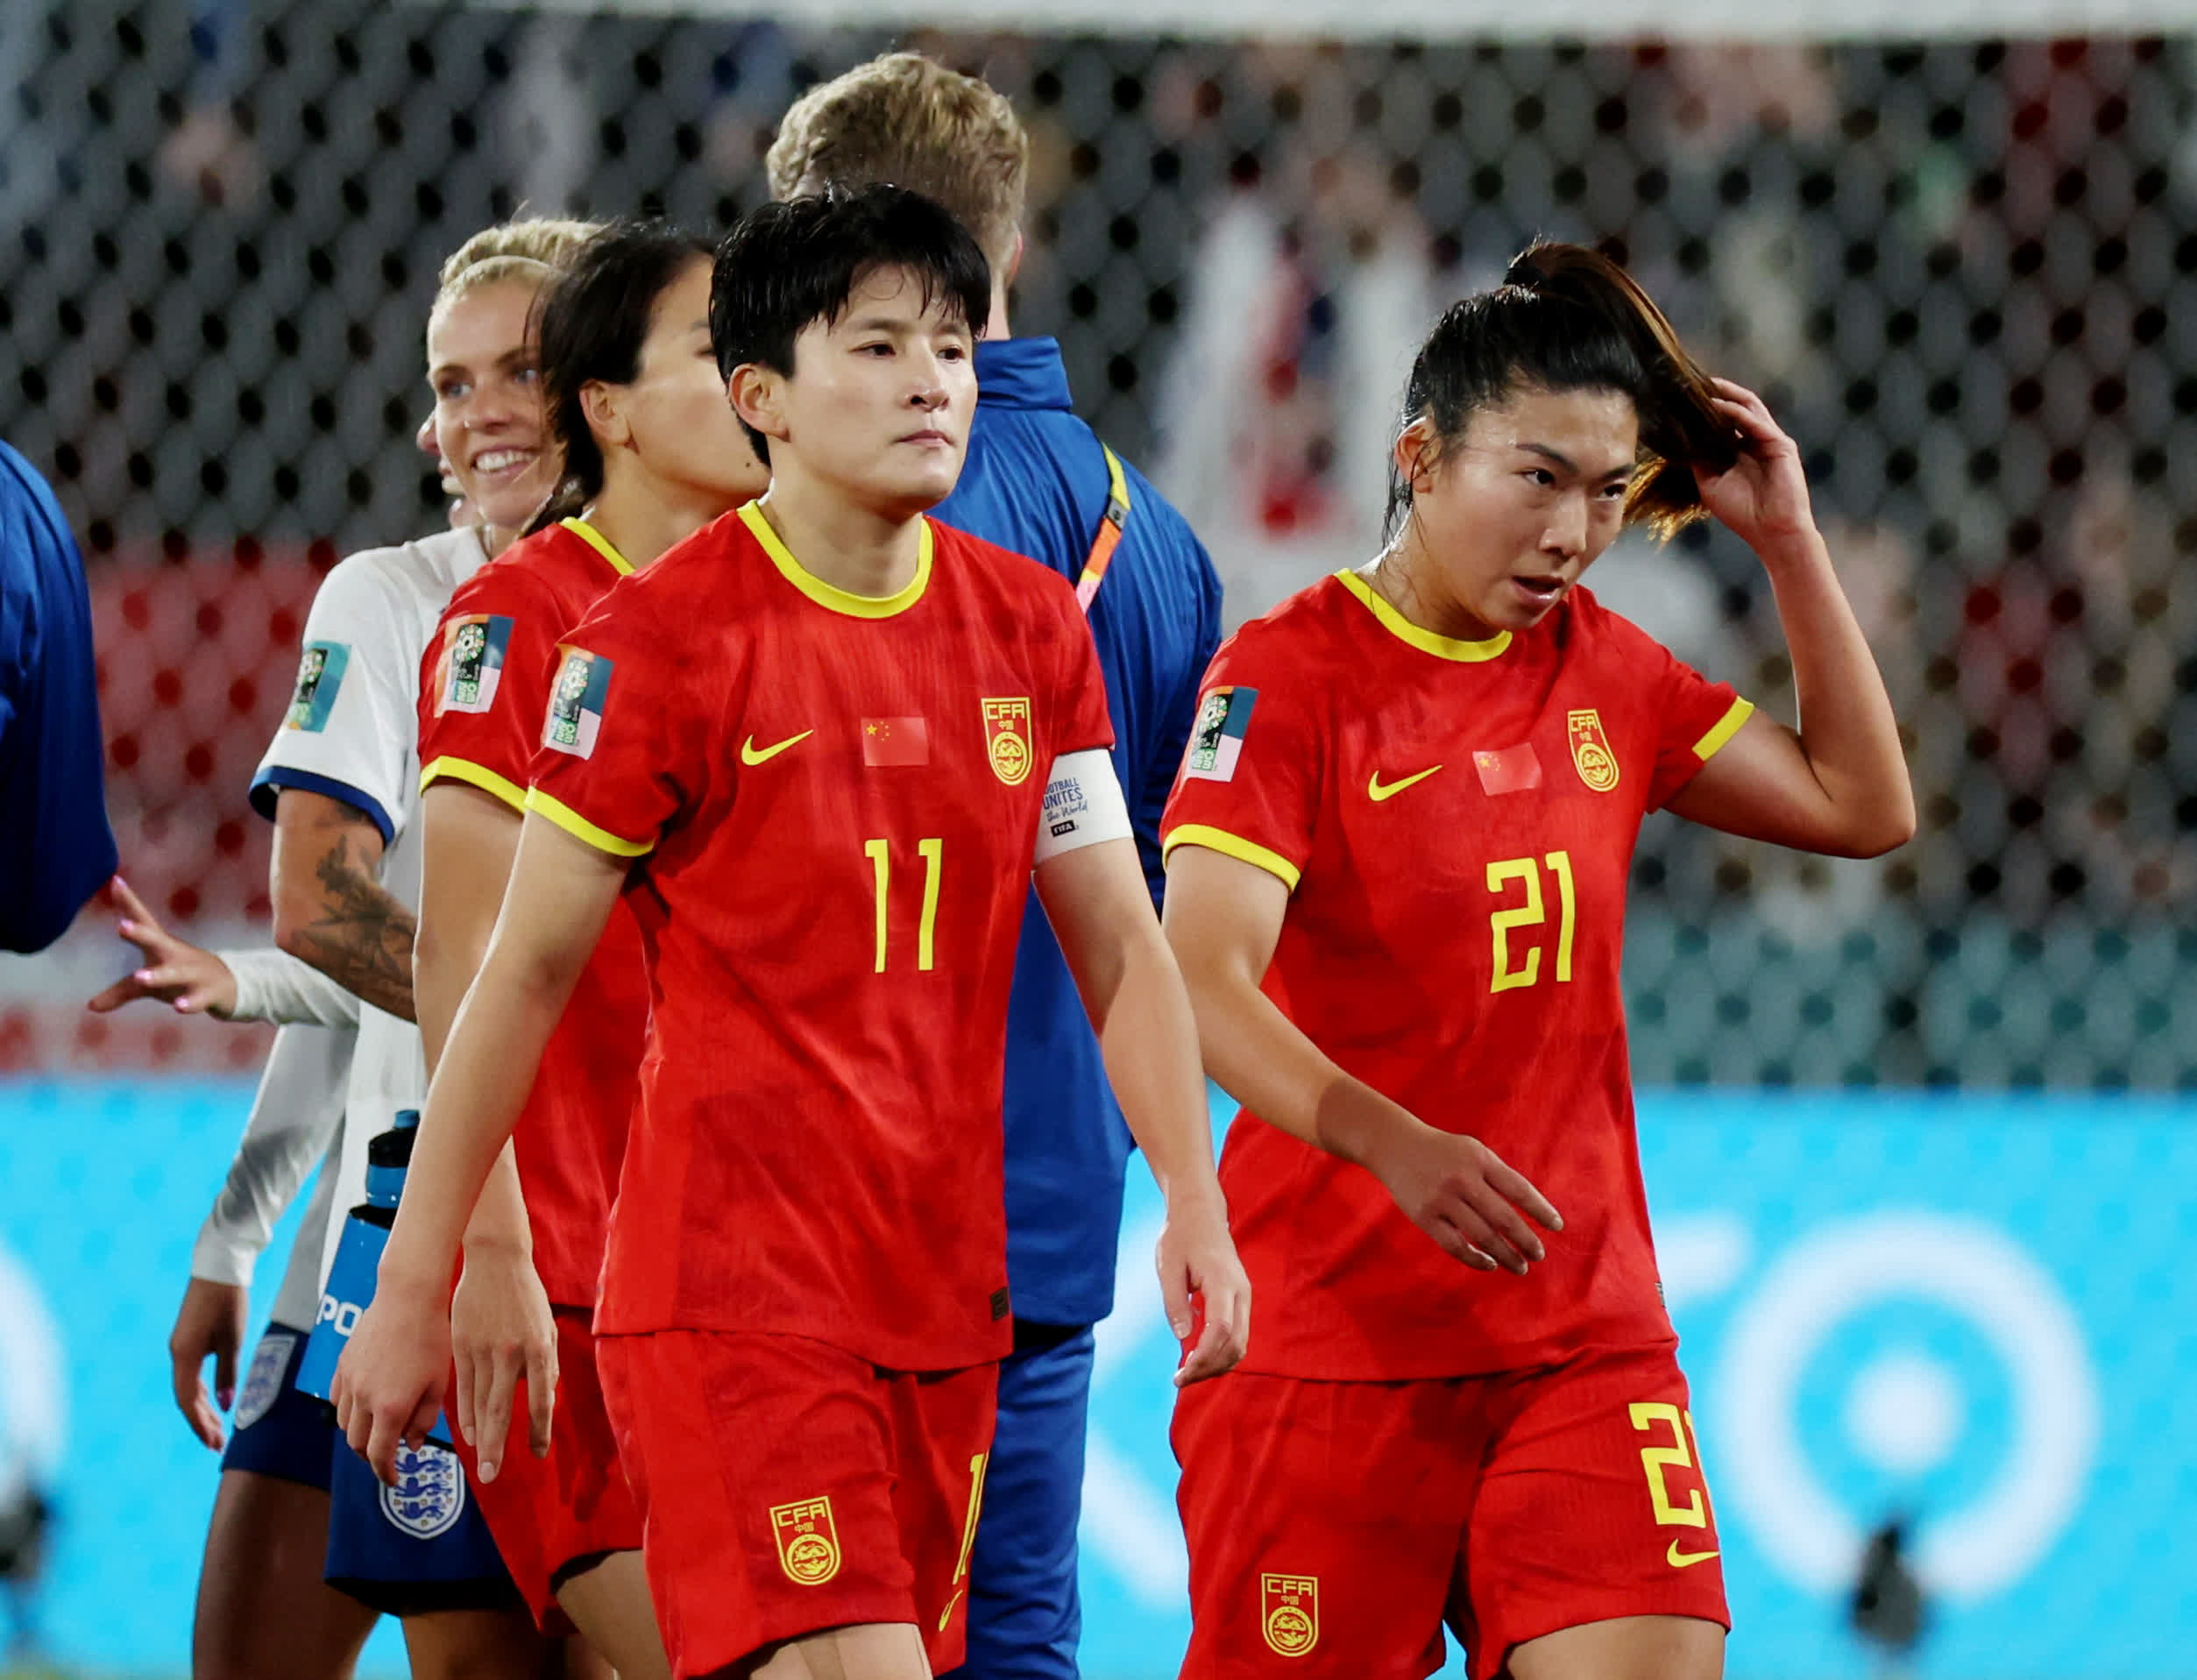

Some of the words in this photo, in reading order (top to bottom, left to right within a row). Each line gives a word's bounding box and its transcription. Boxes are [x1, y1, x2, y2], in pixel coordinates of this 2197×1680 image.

[986, 703, 1025, 720] CFA
[1570, 716, 1598, 732] CFA
[1043, 787, 1083, 809] UNITES
[864, 838, 942, 973] 11
[1485, 850, 1576, 994] 21
[316, 1294, 365, 1337] PO
[776, 1503, 826, 1527] CFA
[1267, 1578, 1313, 1596] CFA
